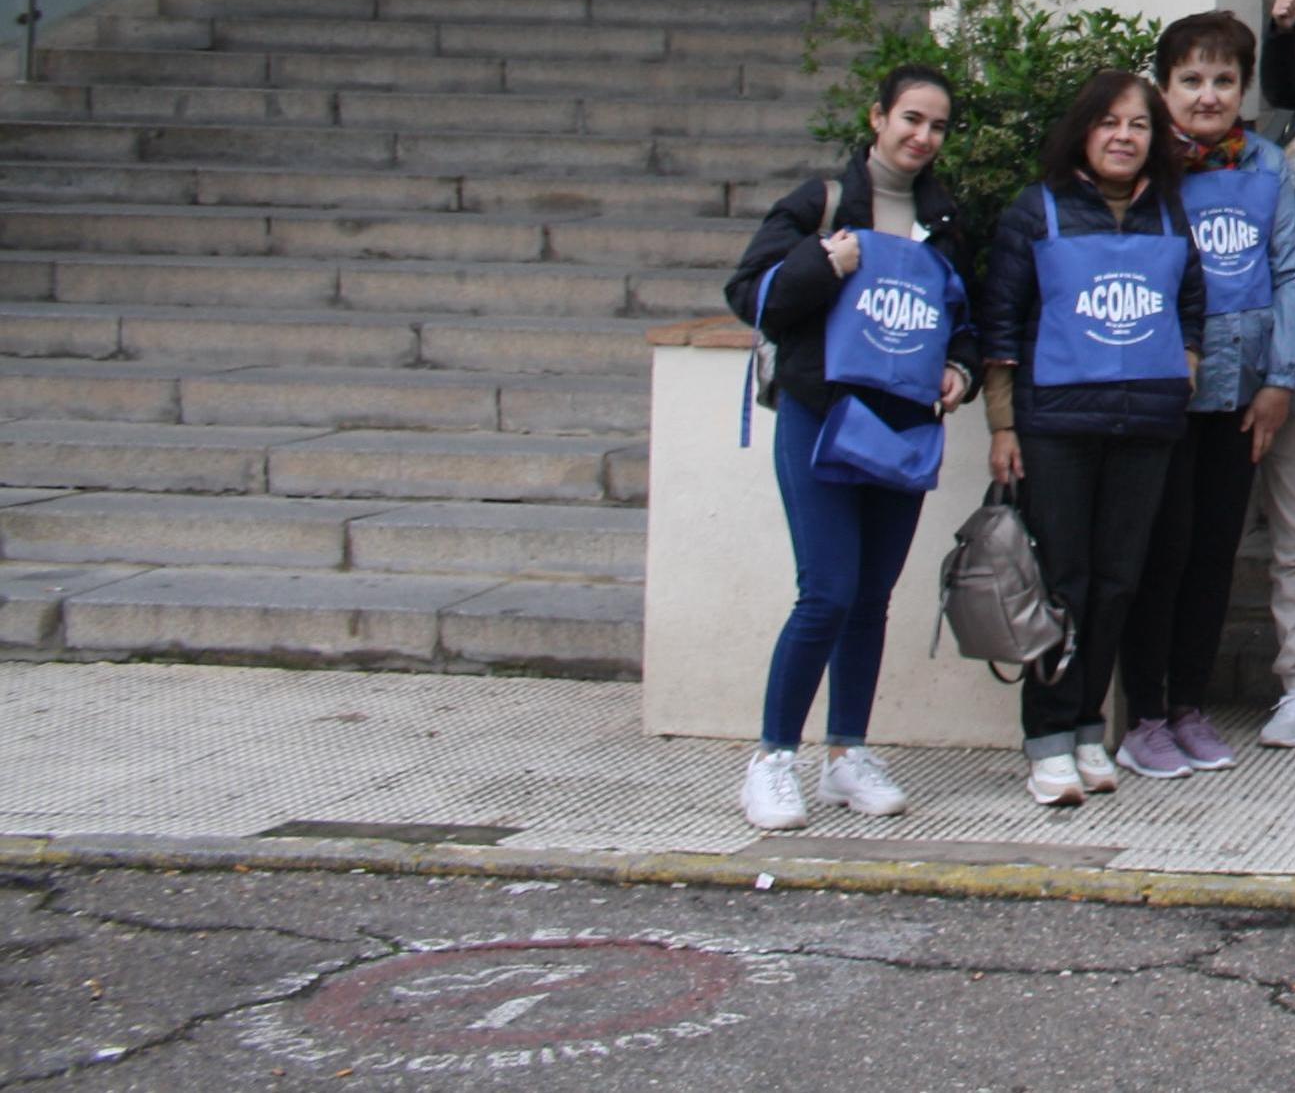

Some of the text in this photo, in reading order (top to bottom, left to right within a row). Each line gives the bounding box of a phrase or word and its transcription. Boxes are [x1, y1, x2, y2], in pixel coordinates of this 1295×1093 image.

[856, 288, 940, 331] ACOARE
[1075, 281, 1163, 322] ACOARE
[529, 926, 612, 941] EL
